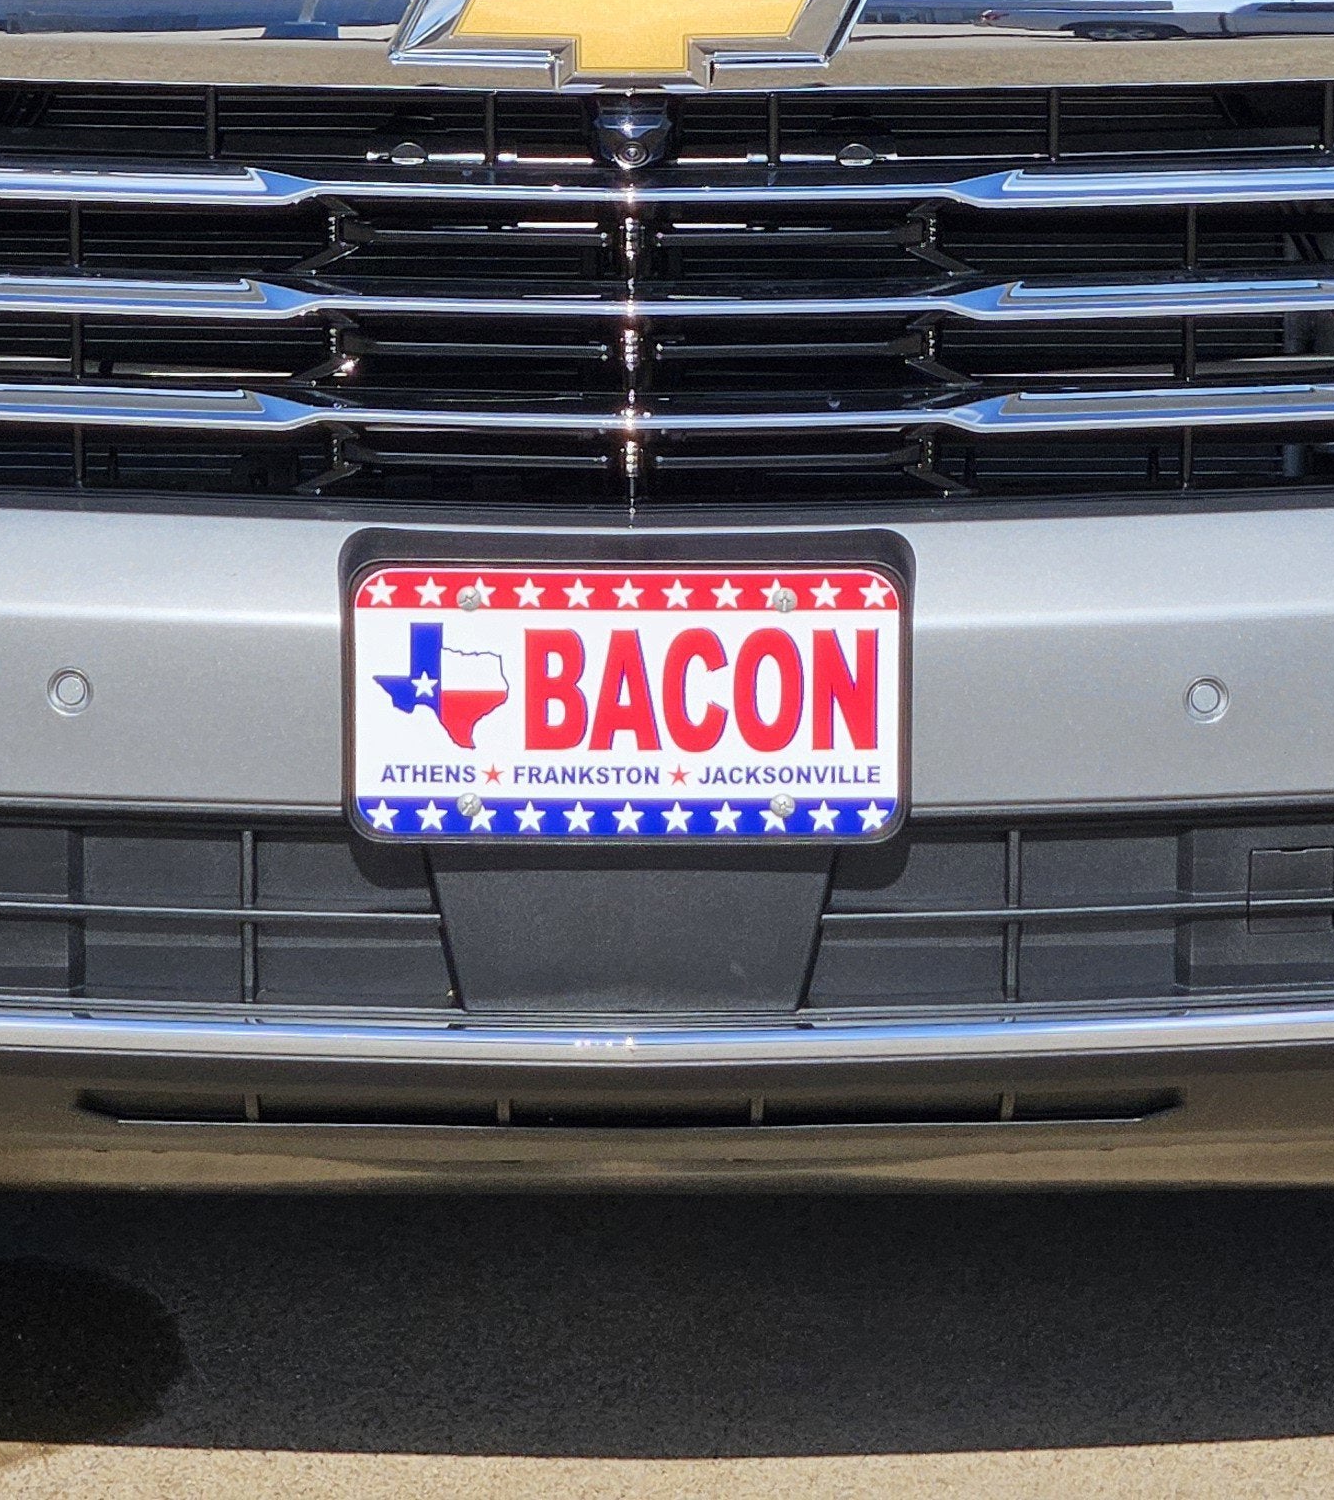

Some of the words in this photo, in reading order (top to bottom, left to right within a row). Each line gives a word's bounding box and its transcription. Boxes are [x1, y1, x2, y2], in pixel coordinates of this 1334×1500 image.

[524, 627, 879, 753] BACON
[380, 764, 476, 784] ATHENS
[513, 765, 660, 785] FRANKSTON
[698, 765, 881, 785] JACKSONVILLE
